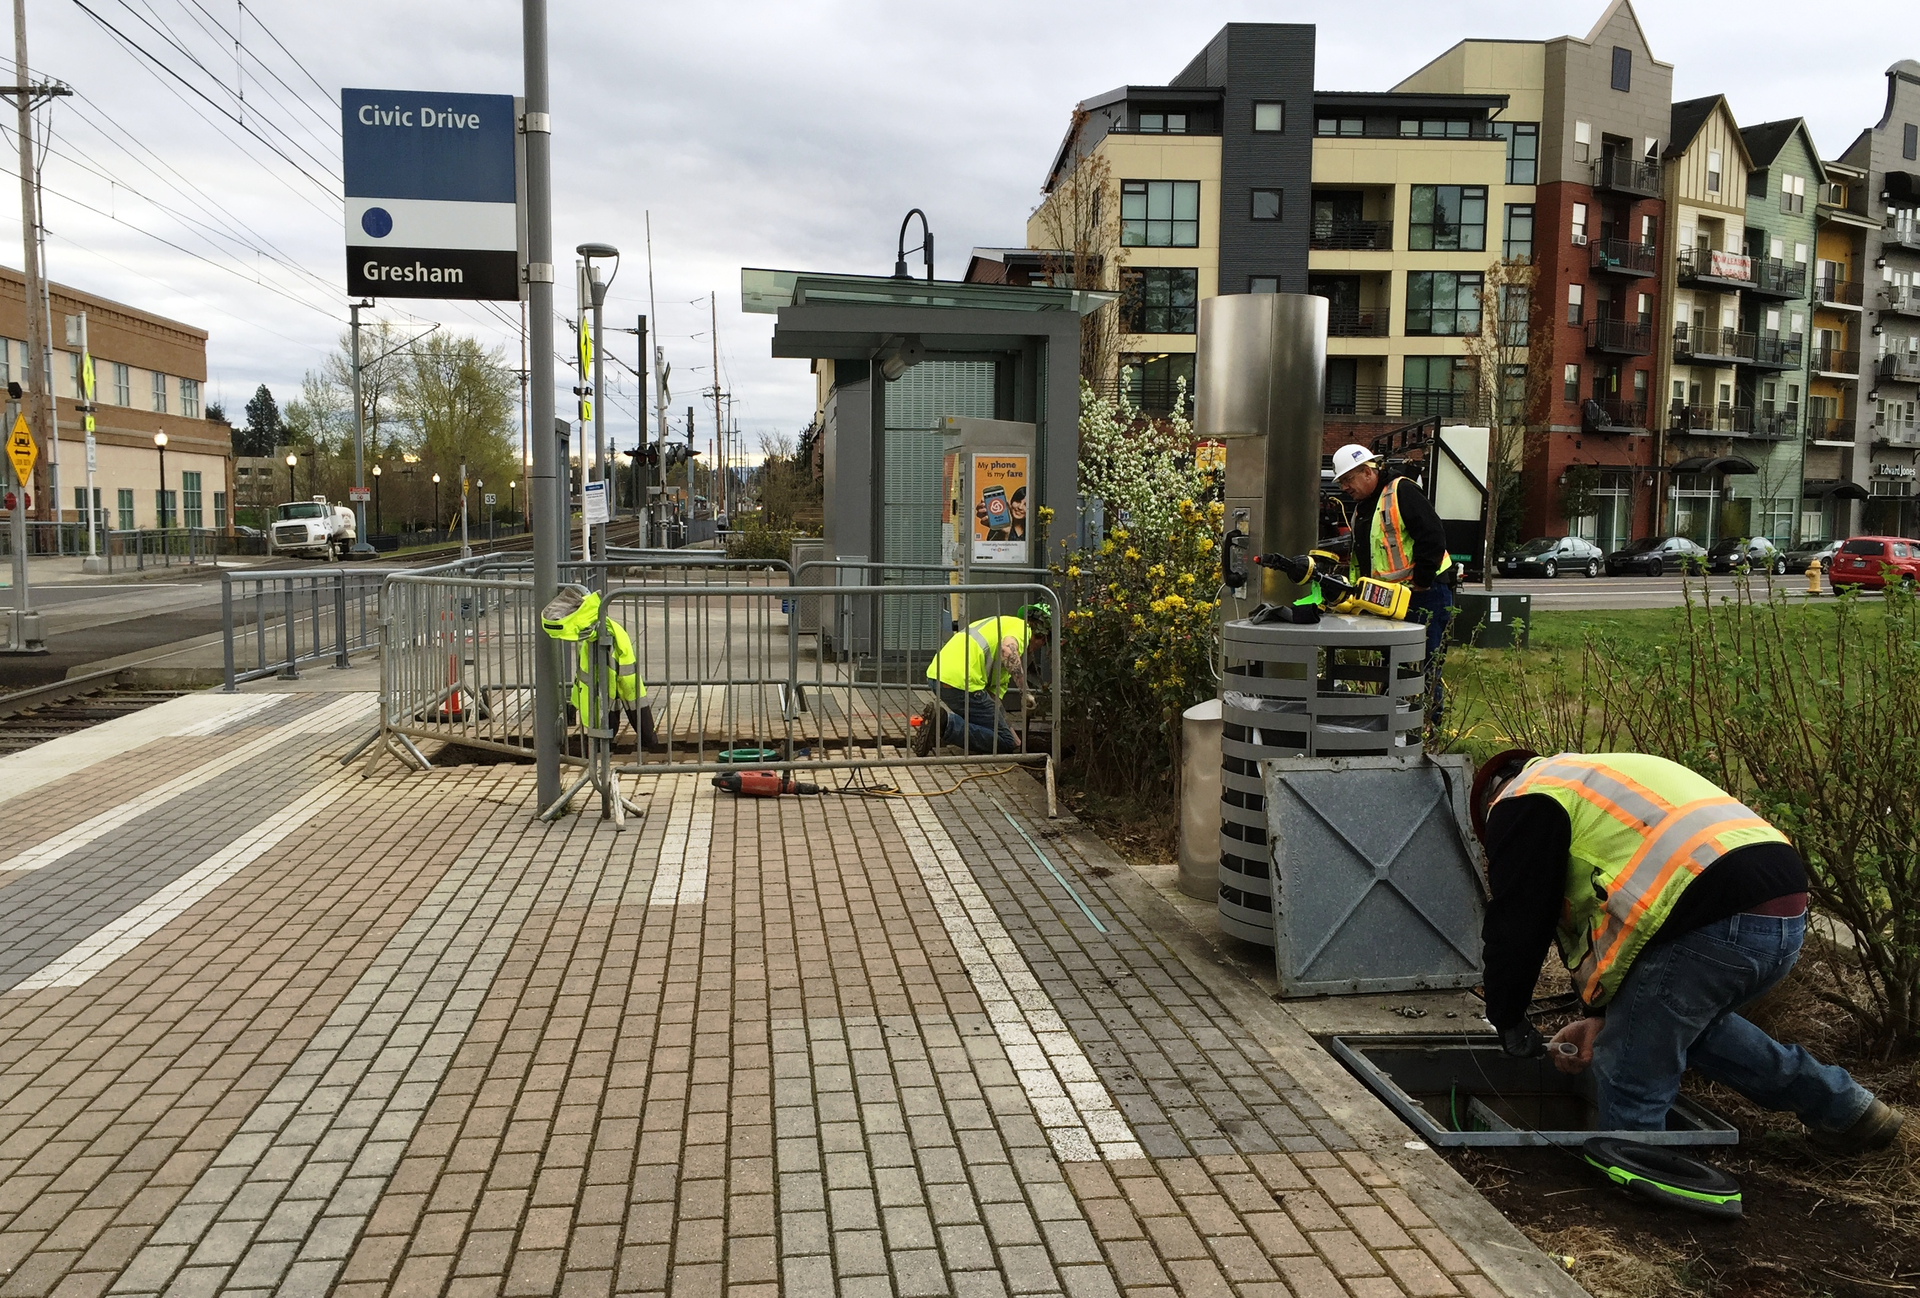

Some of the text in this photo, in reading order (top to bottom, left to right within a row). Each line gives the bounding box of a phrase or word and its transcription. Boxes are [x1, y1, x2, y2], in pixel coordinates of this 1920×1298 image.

[358, 104, 480, 129] Civic Drive
[363, 261, 463, 283] Gresham
[977, 461, 1017, 471] My phone
[994, 471, 1006, 479] my
[1007, 470, 1023, 478] fare
[486, 495, 496, 503] 35
